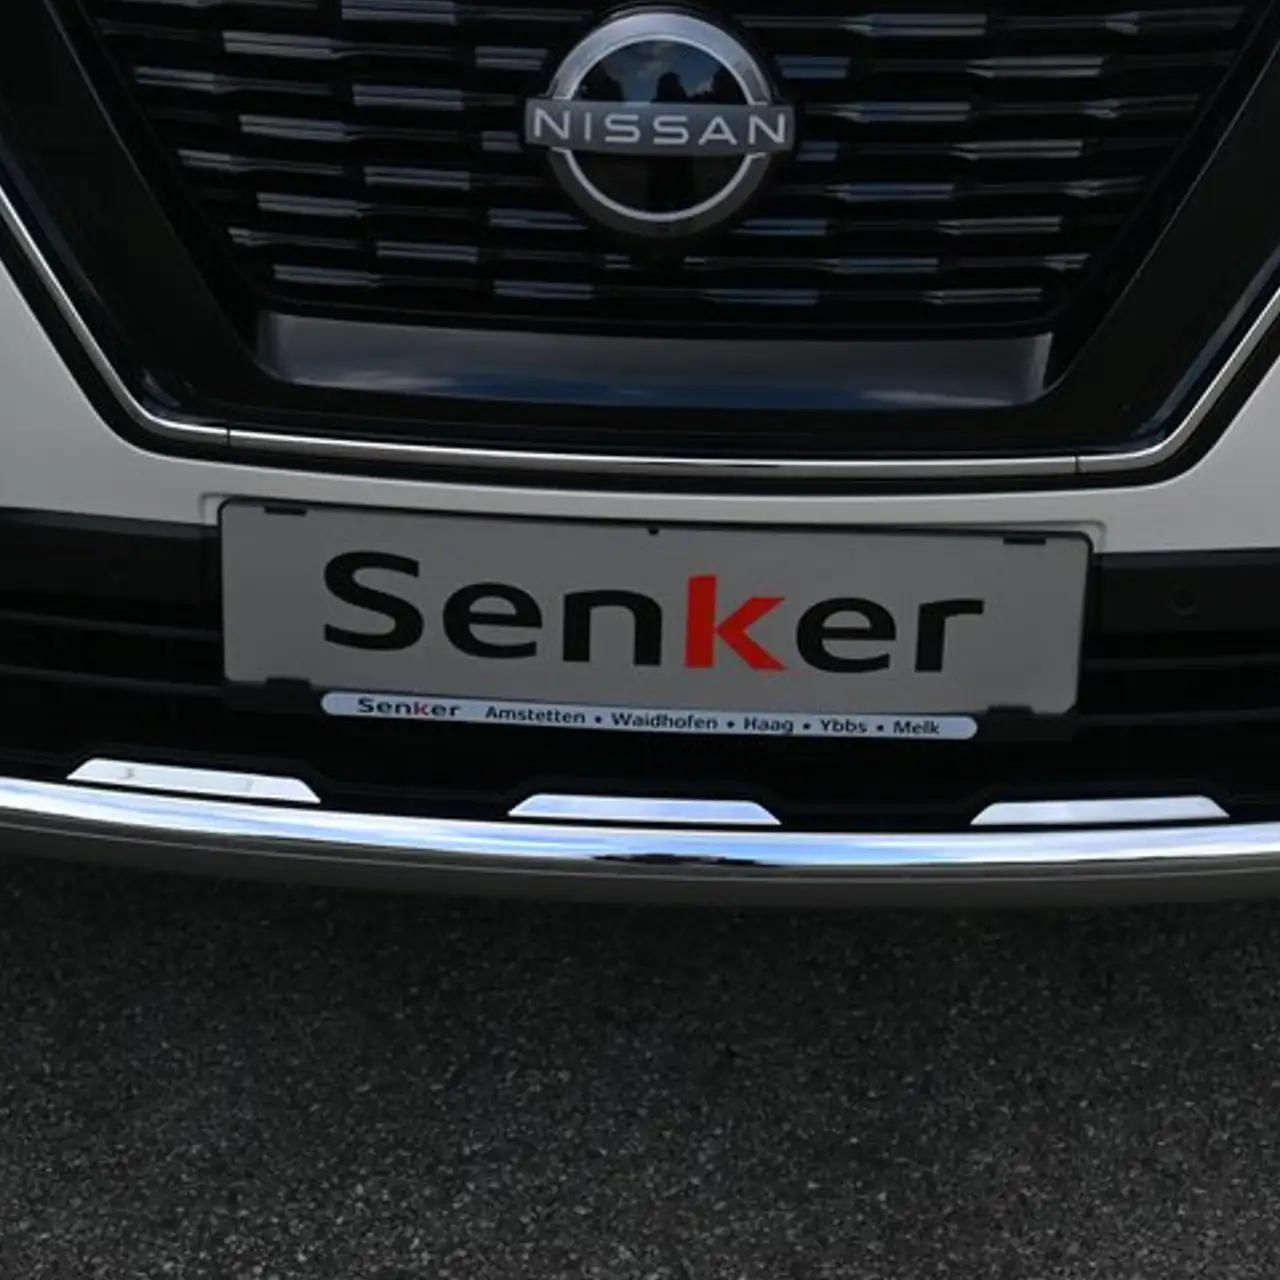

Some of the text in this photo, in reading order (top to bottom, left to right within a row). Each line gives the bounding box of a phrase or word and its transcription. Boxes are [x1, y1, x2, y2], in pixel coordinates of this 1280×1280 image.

[533, 106, 786, 146] NISSAN
[322, 549, 985, 675] Senker
[357, 695, 940, 736] Senker Amstetten Waidhofen Haag Ybbs Melk
